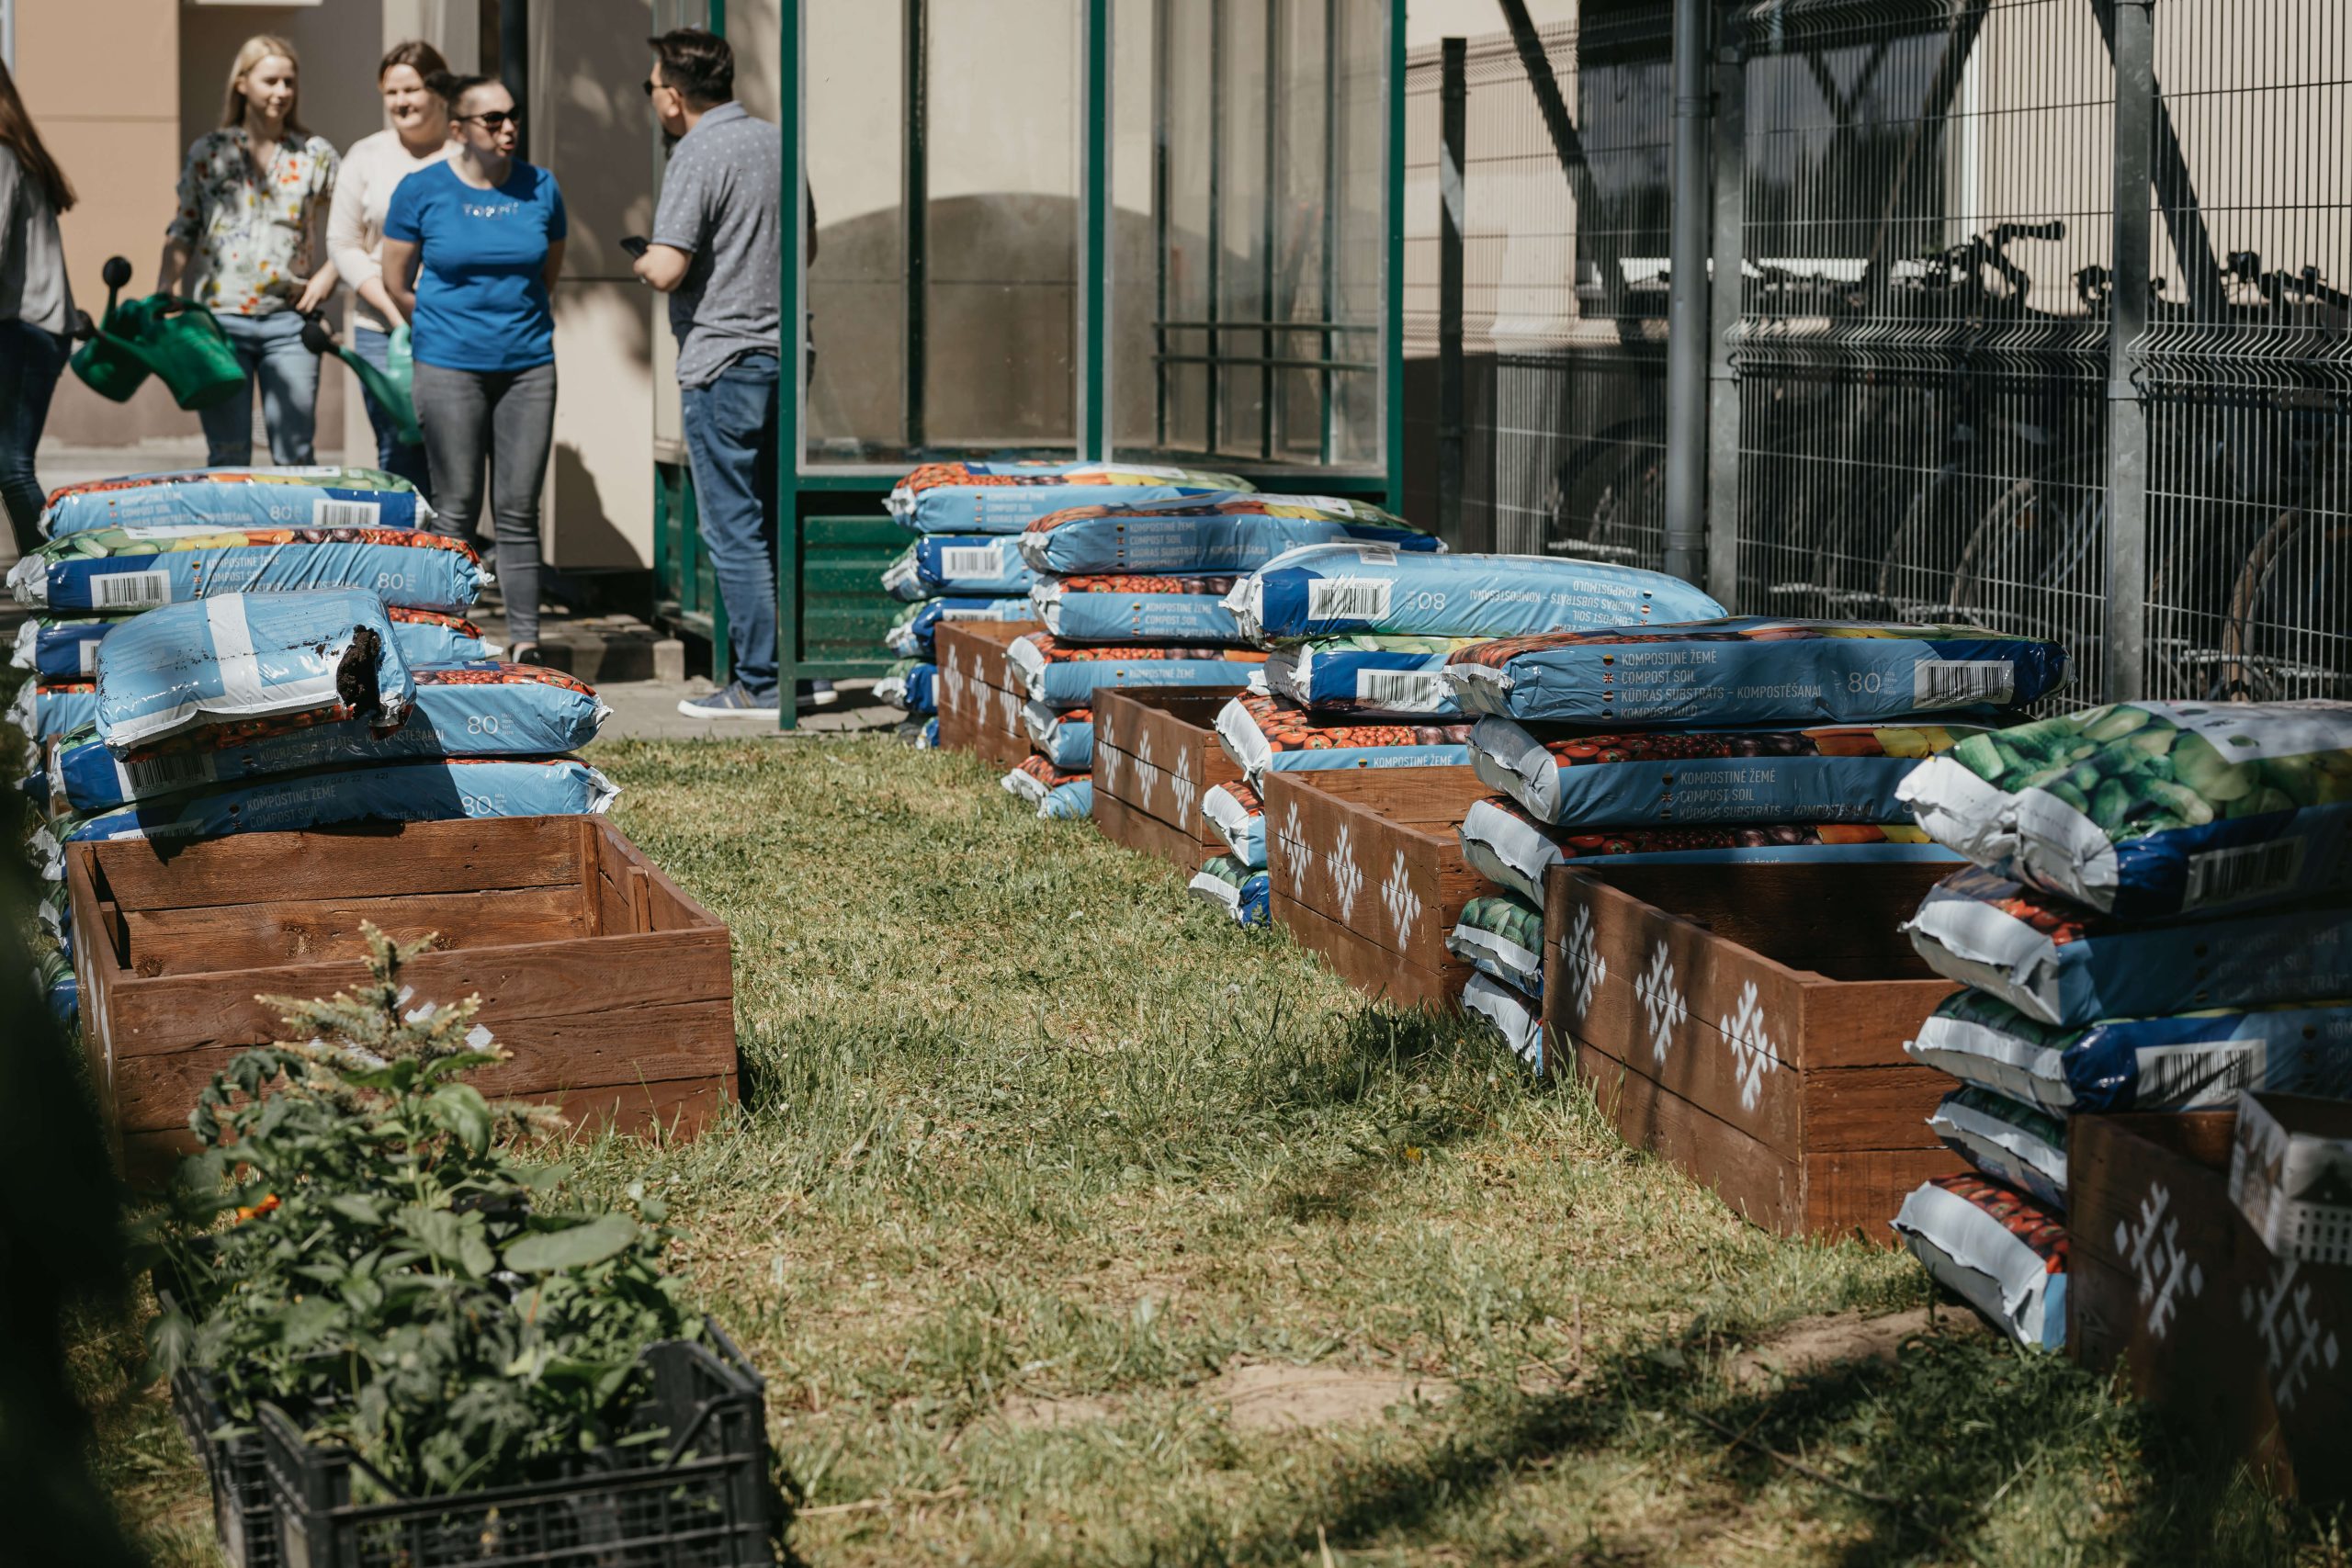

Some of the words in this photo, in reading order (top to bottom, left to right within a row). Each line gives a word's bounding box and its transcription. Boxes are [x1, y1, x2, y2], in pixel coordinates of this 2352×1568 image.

[1129, 536, 1164, 545] COMPOST
[1166, 534, 1182, 544] SOIL
[377, 572, 404, 591] 80
[1418, 592, 1446, 610] 80
[1550, 592, 1607, 608] SUBSTRĀTS
[1611, 600, 1635, 614] KŪDRAS
[1145, 615, 1181, 625] COMPOST
[1572, 609, 1591, 621] SOIL
[1621, 650, 1688, 666] KOMPOSTINĖ
[1690, 649, 1717, 664] ŽEMĖ
[1621, 671, 1671, 684] COMPOST
[1673, 669, 1697, 682] SOIL
[1848, 671, 1881, 694] 80
[1621, 687, 1663, 703] KŪDRAS
[1665, 684, 1724, 701] SUBSTRĀTS
[1736, 682, 1822, 700] KOMPOSTĒŠANAI
[466, 716, 499, 736] 80
[1374, 755, 1429, 768] KOMPOSTINĖ
[1430, 753, 1453, 766] ŽEMĖ
[1680, 768, 1747, 785] KOMPOSTINĖ
[1748, 766, 1776, 784] ŽEMĖ
[1679, 789, 1728, 803] COMPOST
[1731, 788, 1755, 801] SOIL
[460, 795, 492, 816] 80
[1723, 802, 1781, 818] SUBSTRĀTS
[249, 809, 296, 829] COMPOST
[297, 806, 319, 820] SOIL
